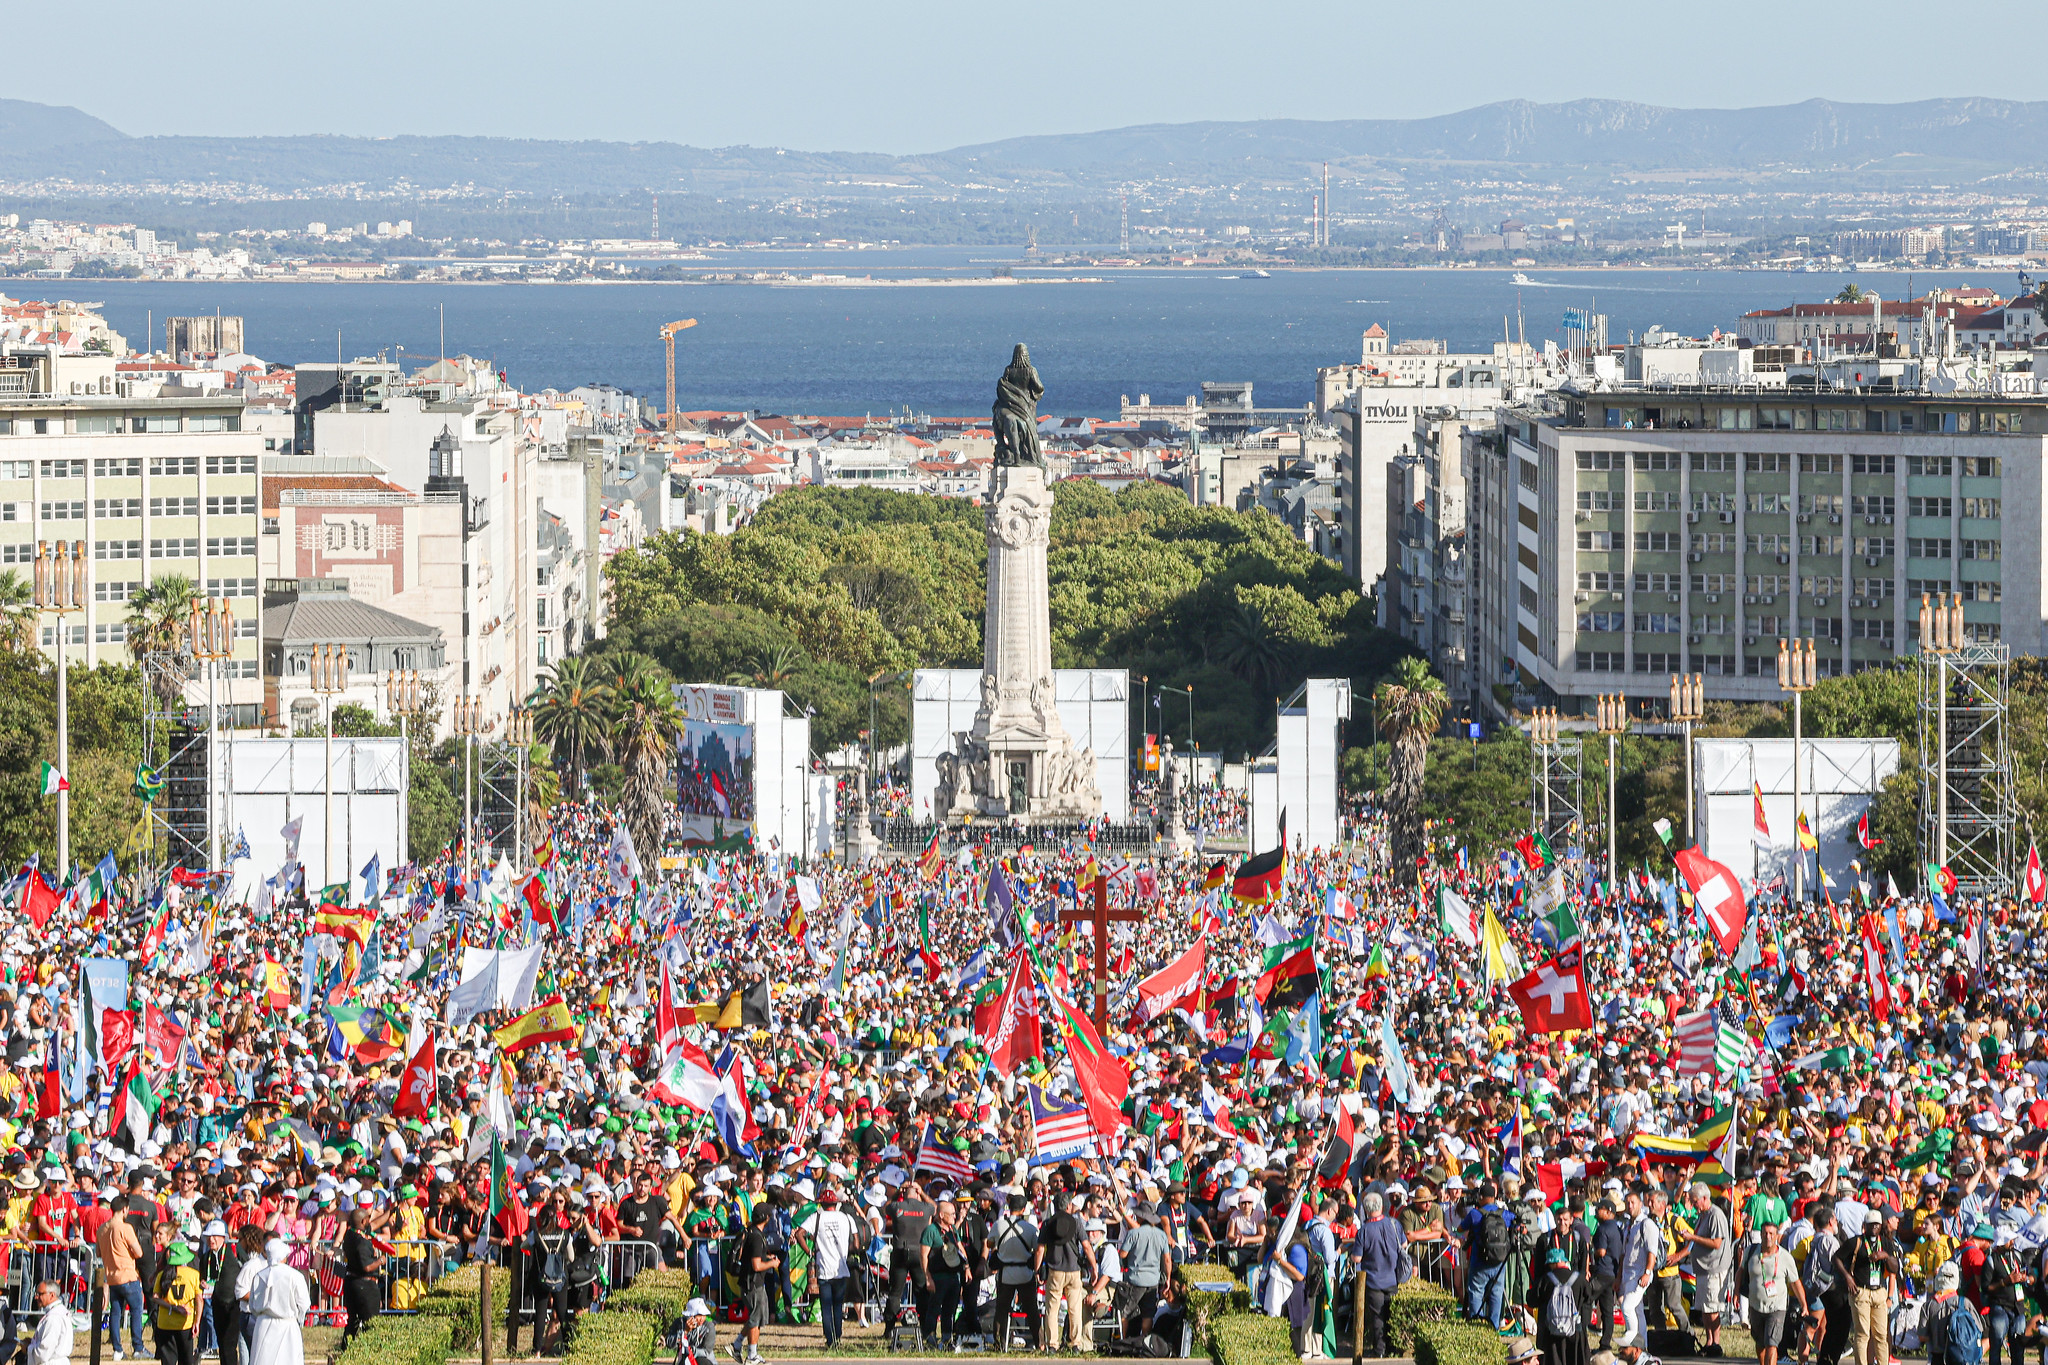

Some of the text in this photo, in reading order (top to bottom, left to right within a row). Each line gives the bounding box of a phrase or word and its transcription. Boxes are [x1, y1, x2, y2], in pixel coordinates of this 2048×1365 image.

[1650, 368, 1692, 383] Banco
[1365, 398, 1408, 417] TIVOLI
[770, 859, 777, 872] P
